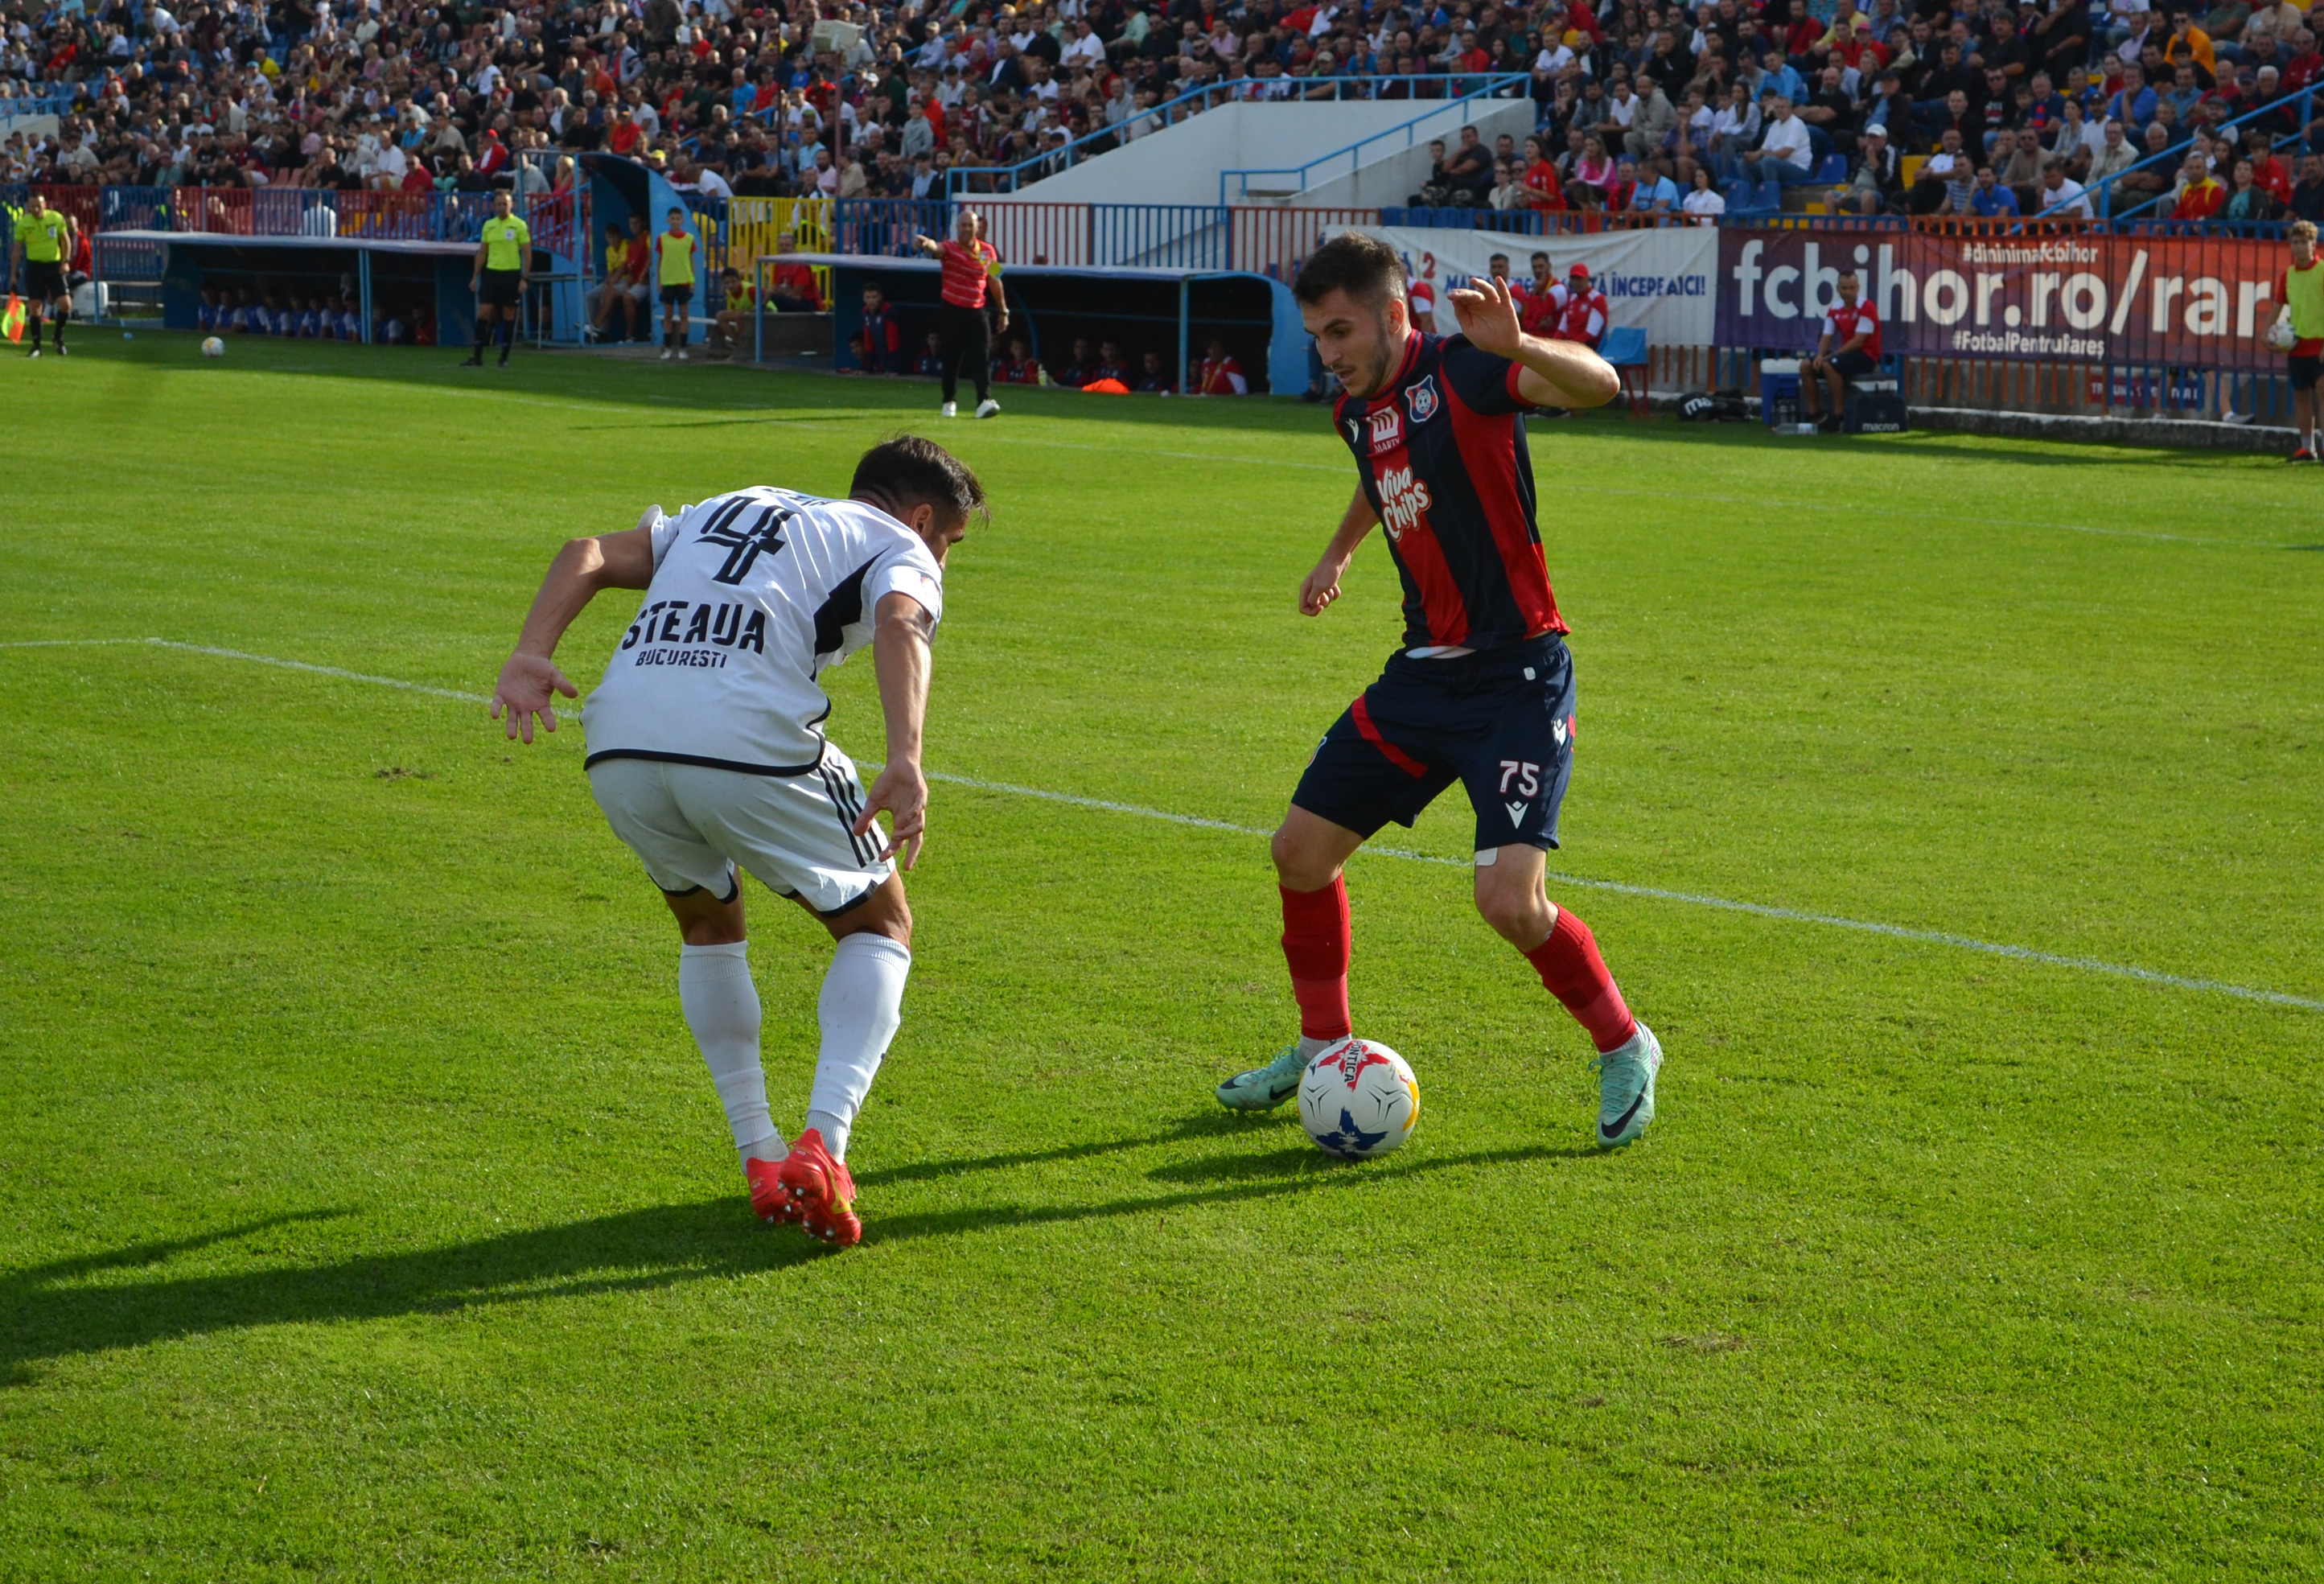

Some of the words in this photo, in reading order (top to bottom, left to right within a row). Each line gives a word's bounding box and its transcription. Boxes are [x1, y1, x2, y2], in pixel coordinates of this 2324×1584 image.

[1963, 242, 2099, 263] #dininimafcbihor
[1667, 275, 1706, 296] AICI!
[1734, 239, 2291, 338] fcbihor.ro/rar
[1862, 422, 1899, 432] macron
[1377, 467, 1413, 504] Viva
[1384, 483, 1429, 539] Chips
[693, 496, 801, 585] 4
[622, 601, 766, 656] STEAUA
[1499, 760, 1540, 796] 75
